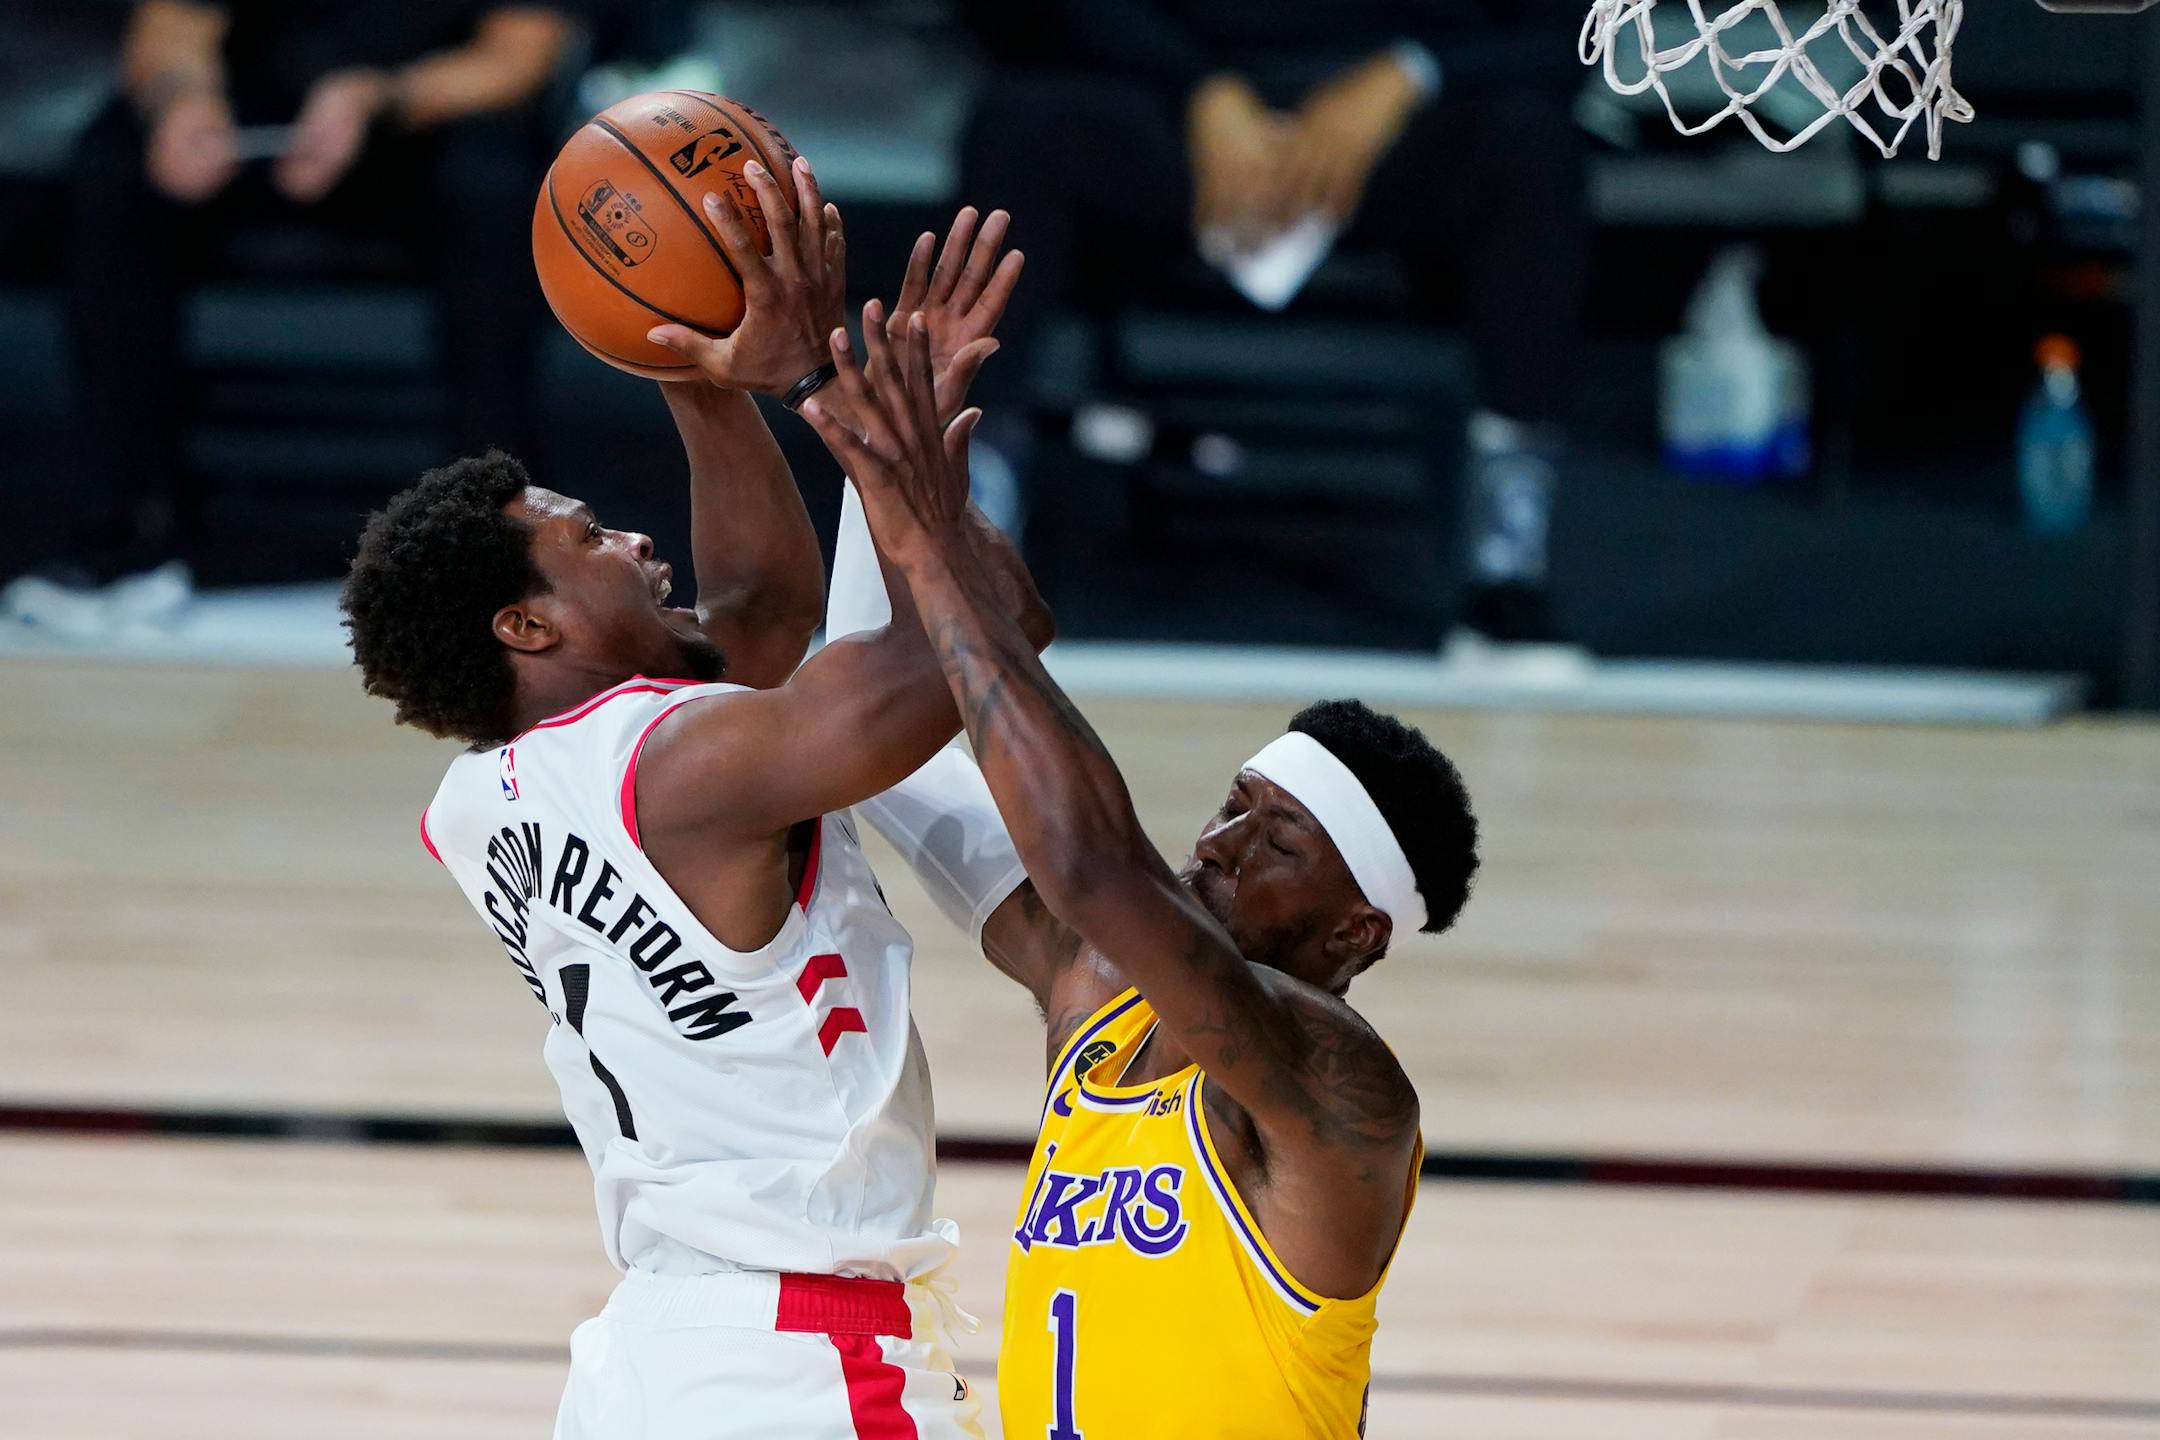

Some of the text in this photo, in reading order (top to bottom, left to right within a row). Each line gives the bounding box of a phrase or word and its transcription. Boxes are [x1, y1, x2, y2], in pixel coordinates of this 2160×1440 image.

[672, 153, 691, 172] NBA
[549, 833, 753, 1039] REFORM
[1143, 1088, 1182, 1117] ish
[1013, 1142, 1189, 1256] LKRS
[1048, 1290, 1083, 1440] 1
